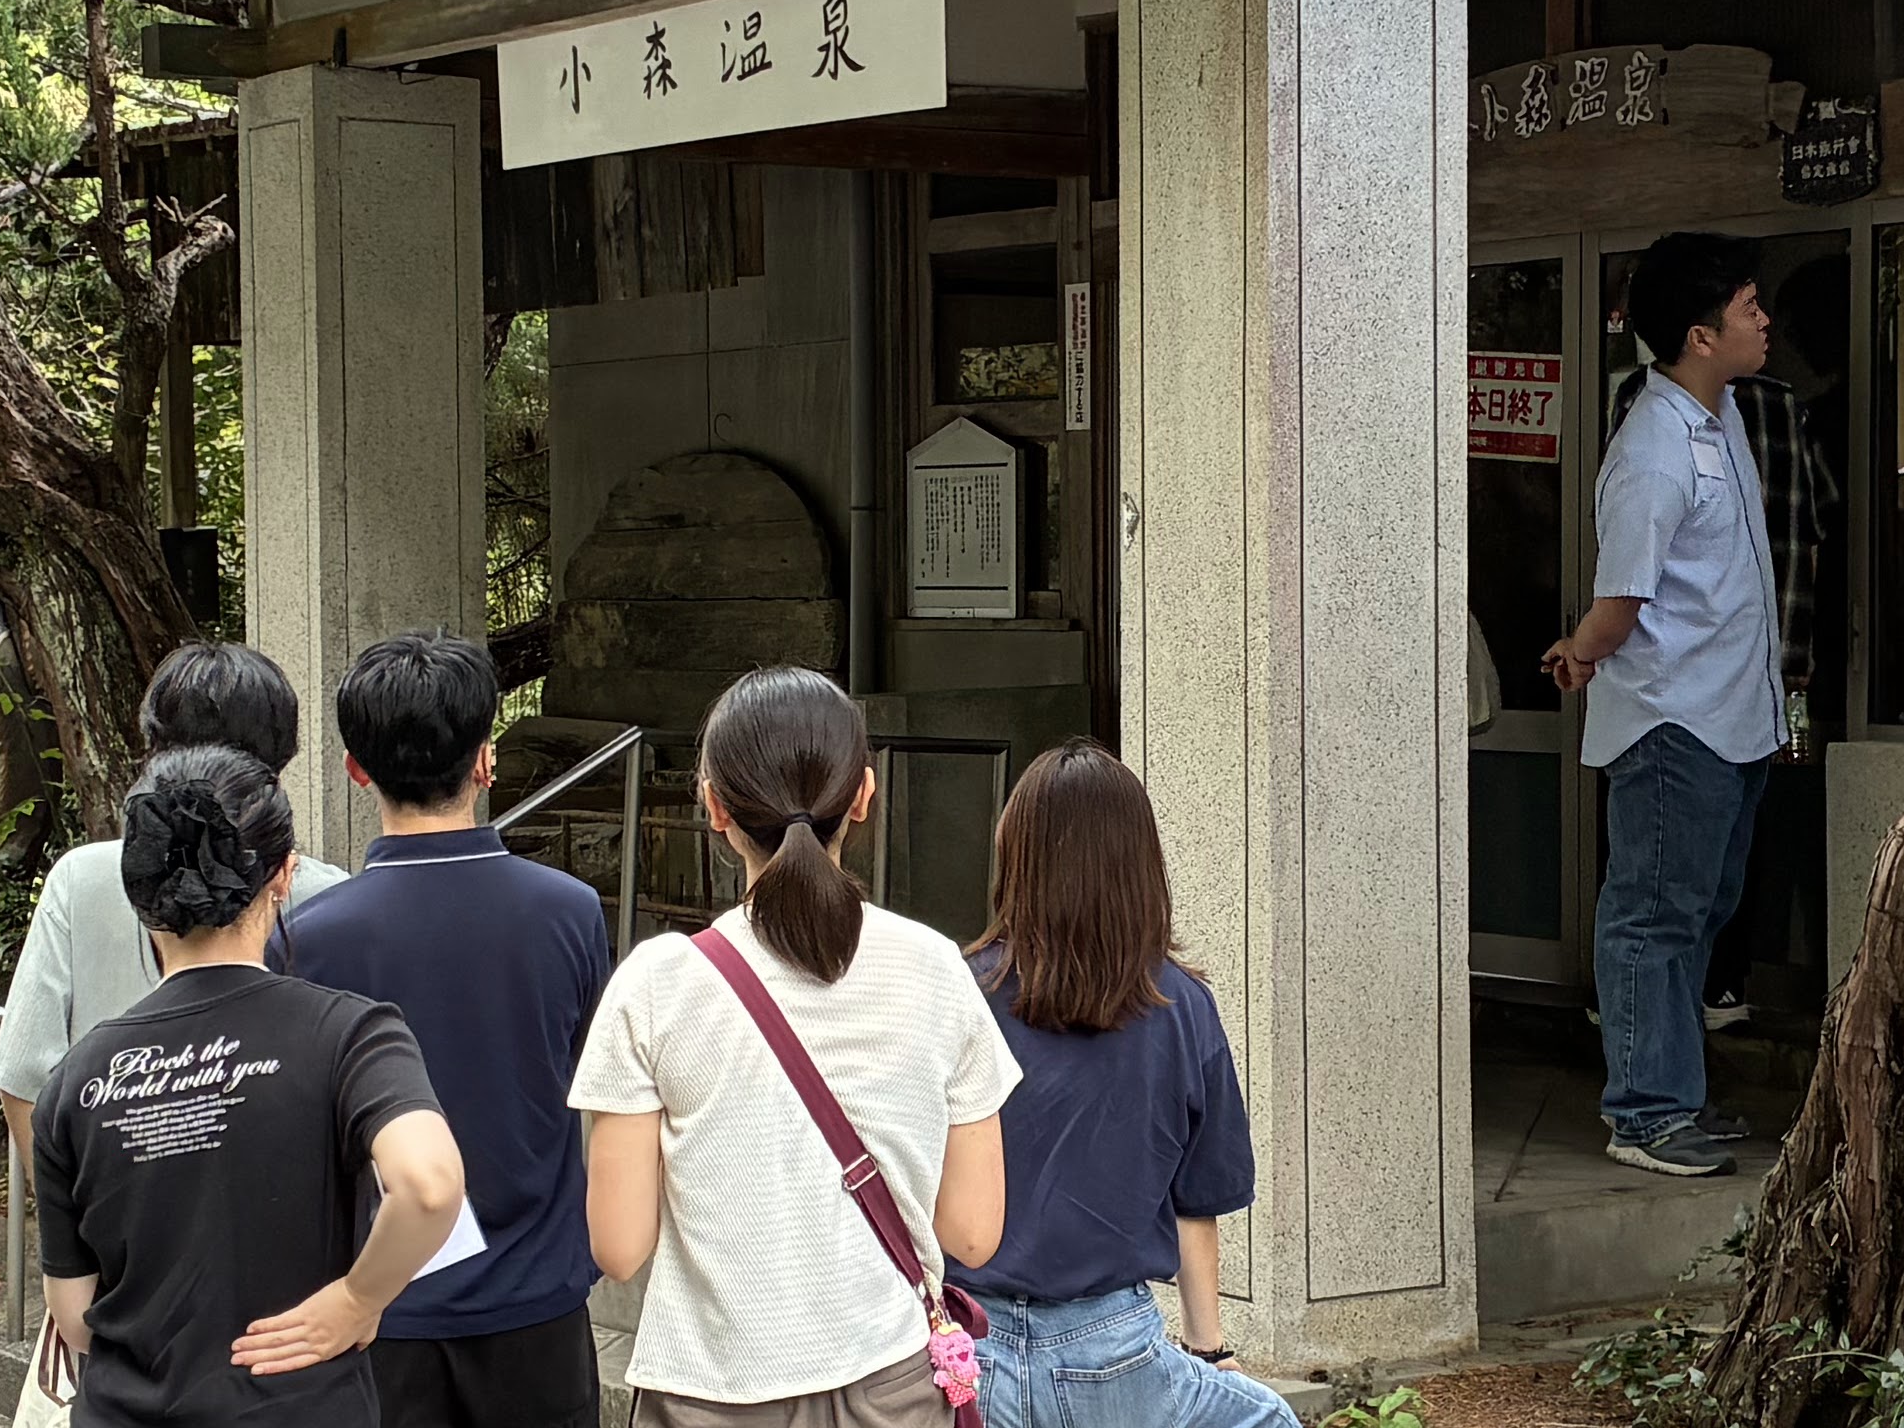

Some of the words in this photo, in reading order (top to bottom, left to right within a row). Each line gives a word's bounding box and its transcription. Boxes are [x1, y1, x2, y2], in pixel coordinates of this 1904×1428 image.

[108, 1044, 195, 1077] Rock
[200, 1035, 241, 1063] the
[79, 1071, 167, 1110] World
[171, 1062, 227, 1092] with
[222, 1058, 281, 1093] you
